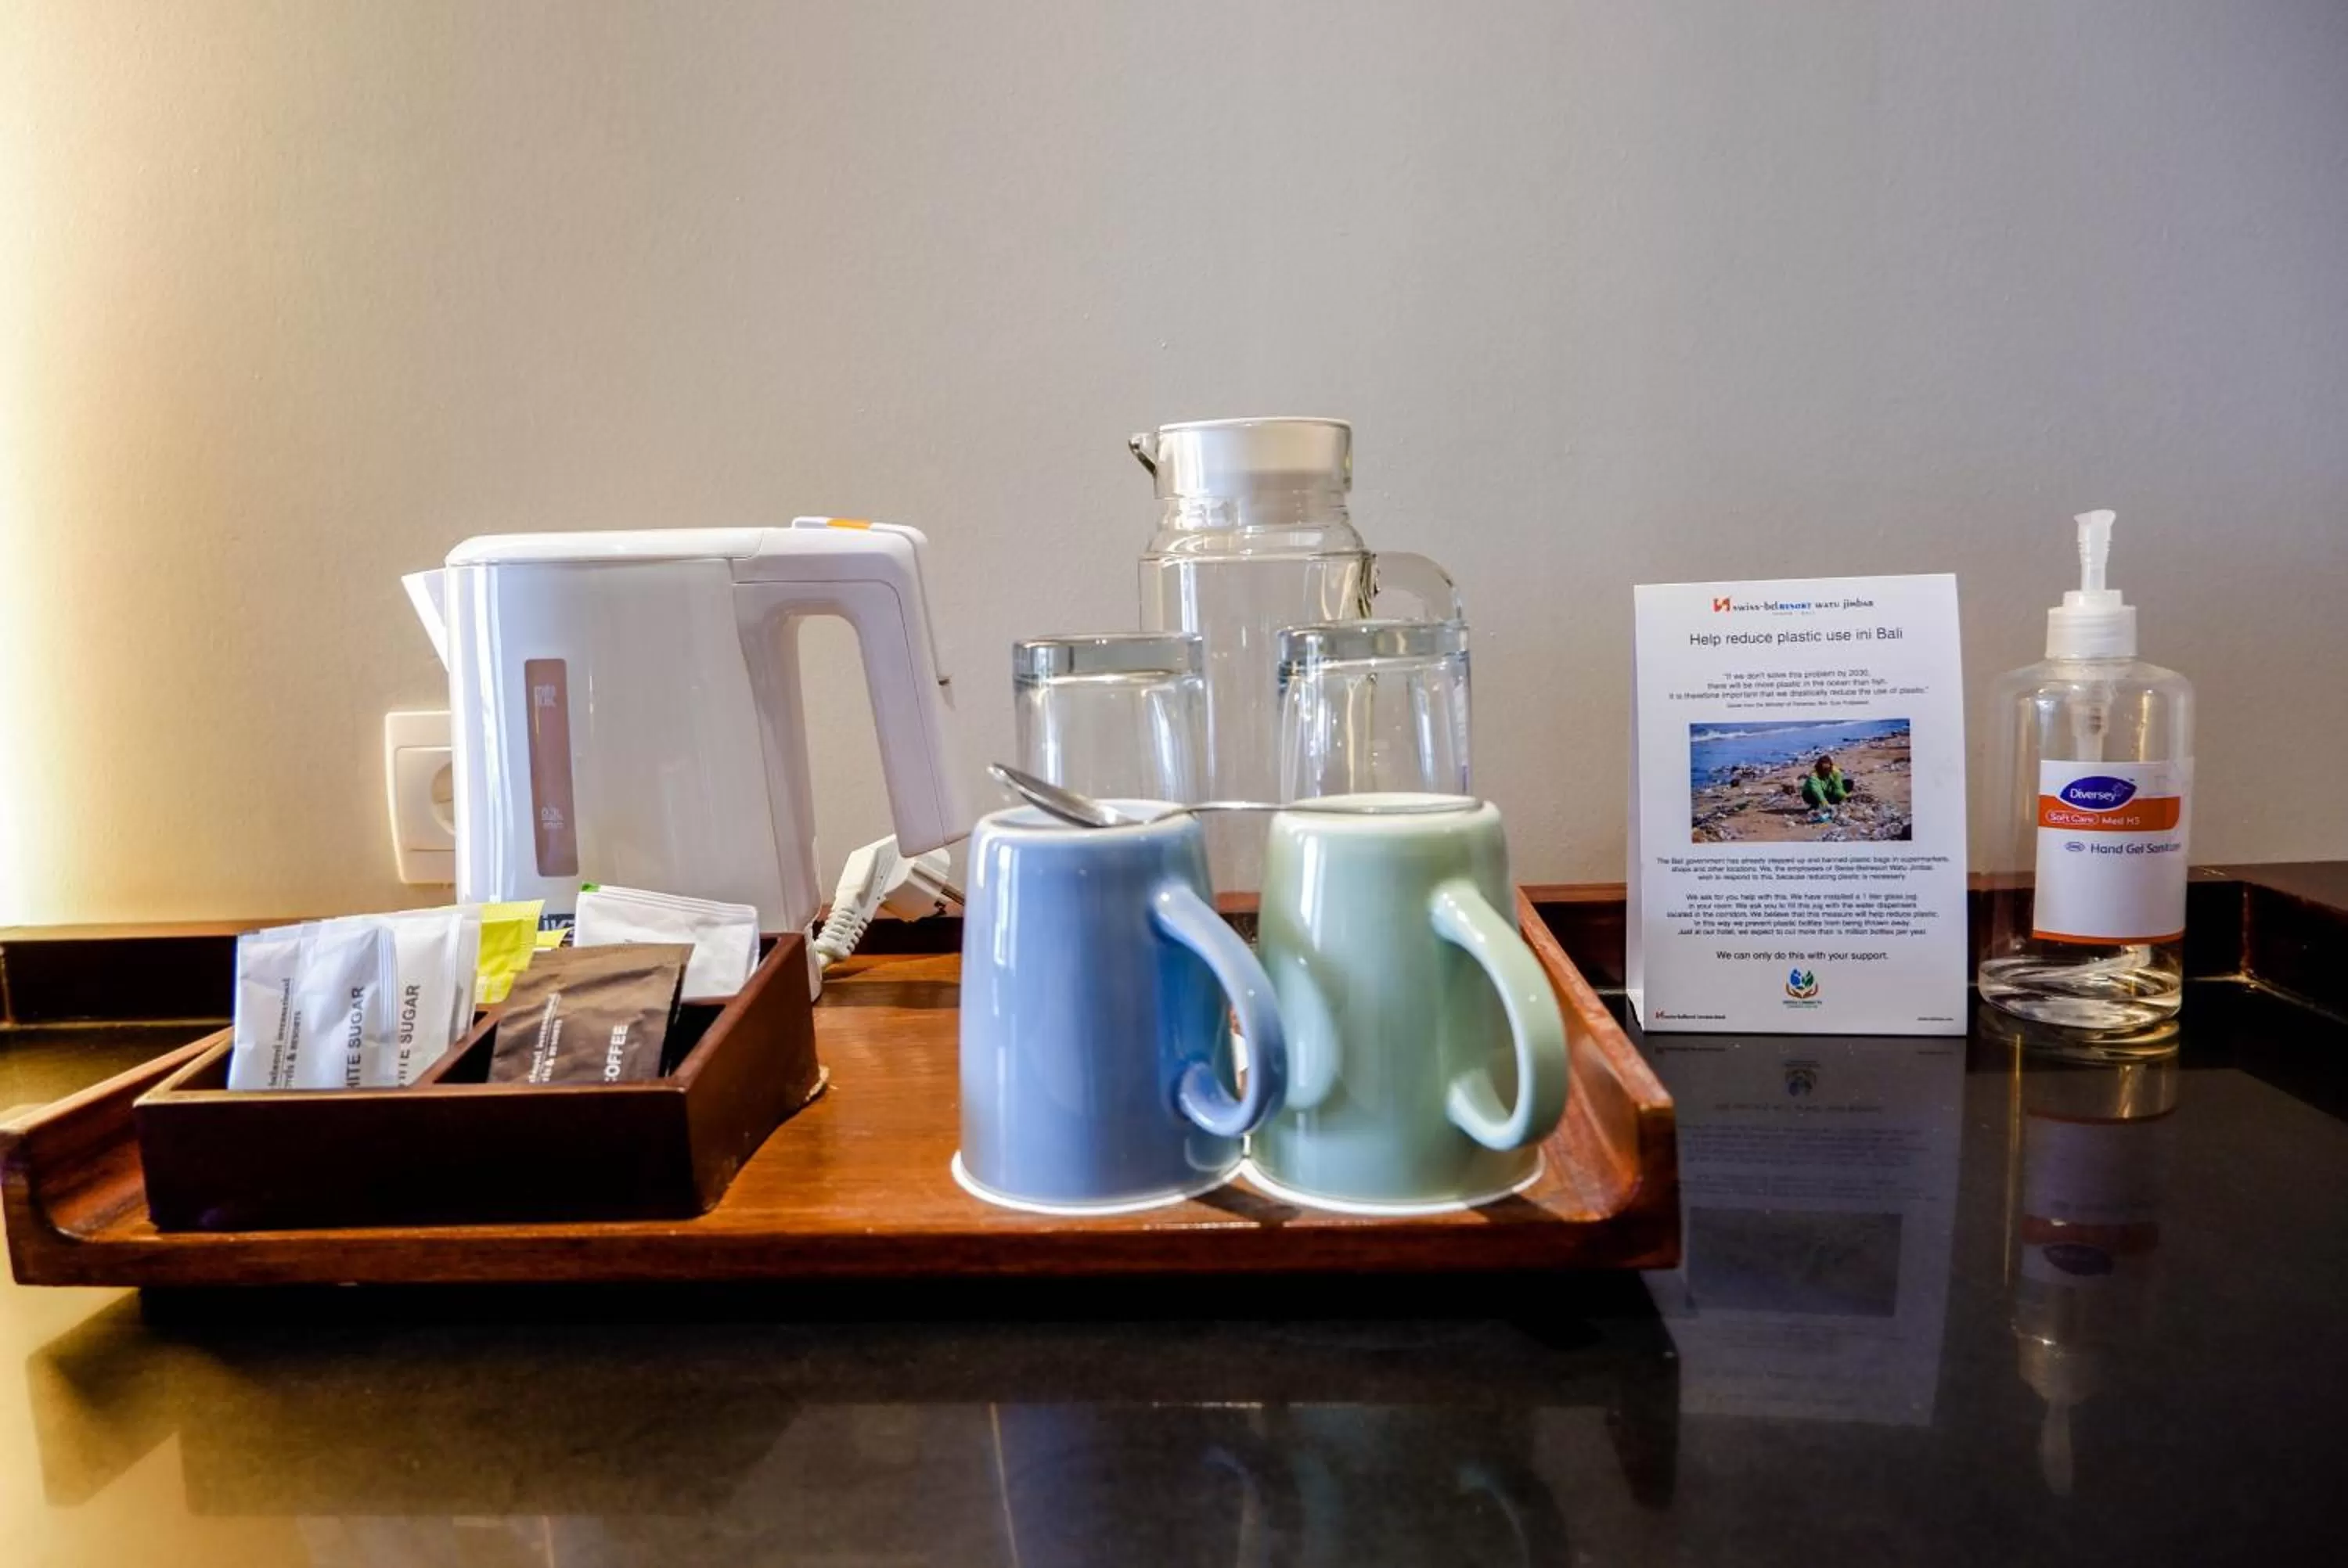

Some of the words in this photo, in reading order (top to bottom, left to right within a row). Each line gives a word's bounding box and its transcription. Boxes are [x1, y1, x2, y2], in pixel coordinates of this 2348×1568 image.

[1690, 633, 1721, 649] Help
[1726, 633, 1773, 644] reduce
[1777, 631, 1821, 646] plastic
[1827, 631, 1851, 642] use
[1856, 629, 1871, 640] ini
[1877, 626, 1903, 639] Bali
[2070, 788, 2115, 802] Diversey
[2050, 811, 2069, 822] Soft
[2091, 843, 2123, 854] Hand
[2126, 843, 2144, 854] Gel
[1716, 951, 1731, 959] We
[1752, 952, 1771, 962] only
[1774, 951, 1785, 960] do
[1788, 951, 1804, 960] this
[1828, 952, 1847, 962] your
[348, 986, 366, 1048] SUGAR
[400, 985, 420, 1044] SUGAR
[604, 1024, 628, 1082] OFFEE
[345, 1053, 362, 1088] ITE
